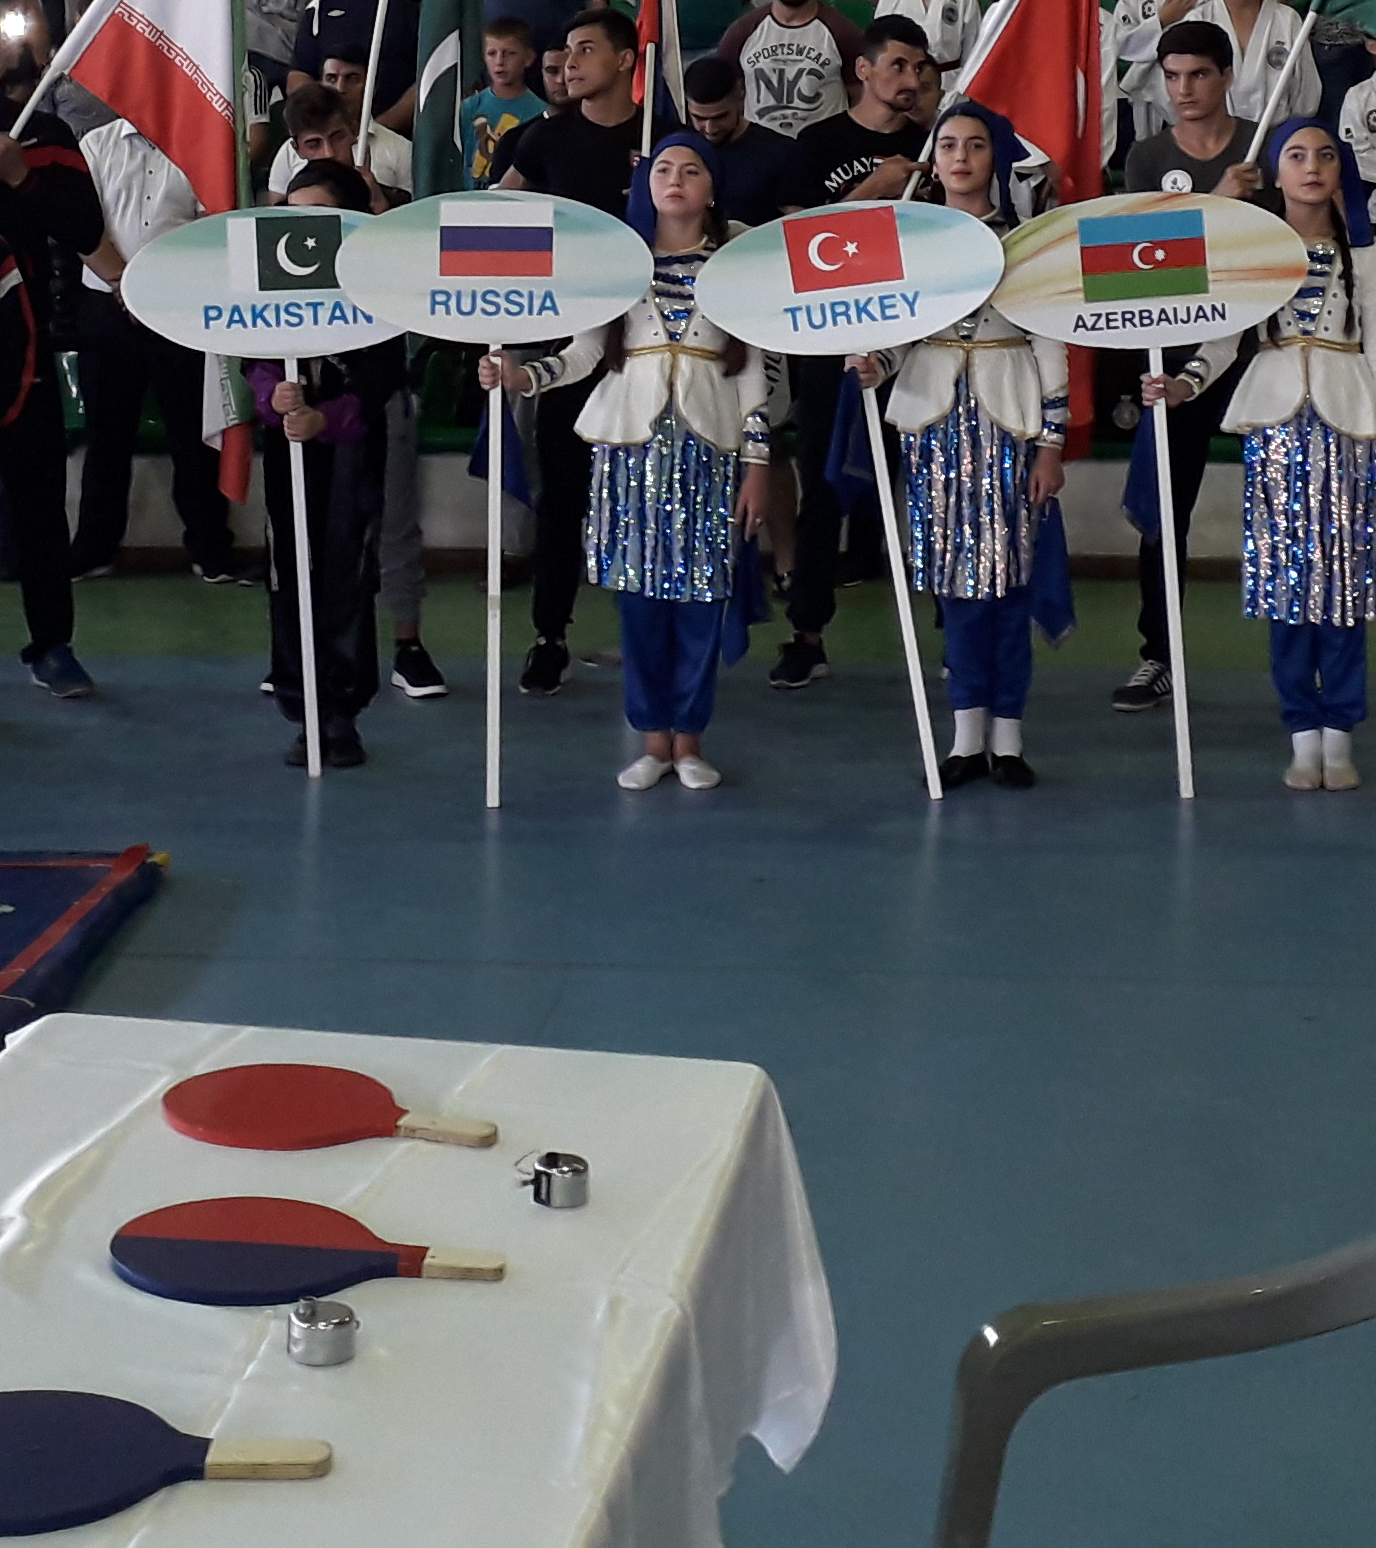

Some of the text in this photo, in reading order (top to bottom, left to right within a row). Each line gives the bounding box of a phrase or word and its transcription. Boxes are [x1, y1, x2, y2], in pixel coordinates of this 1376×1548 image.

[753, 67, 826, 105] NYC
[824, 156, 873, 194] MUAY
[202, 300, 374, 330] PAKISTAN
[428, 289, 561, 318] RUSSIA
[783, 290, 922, 333] TURKEY
[1072, 303, 1227, 334] AZERBAIJAN
